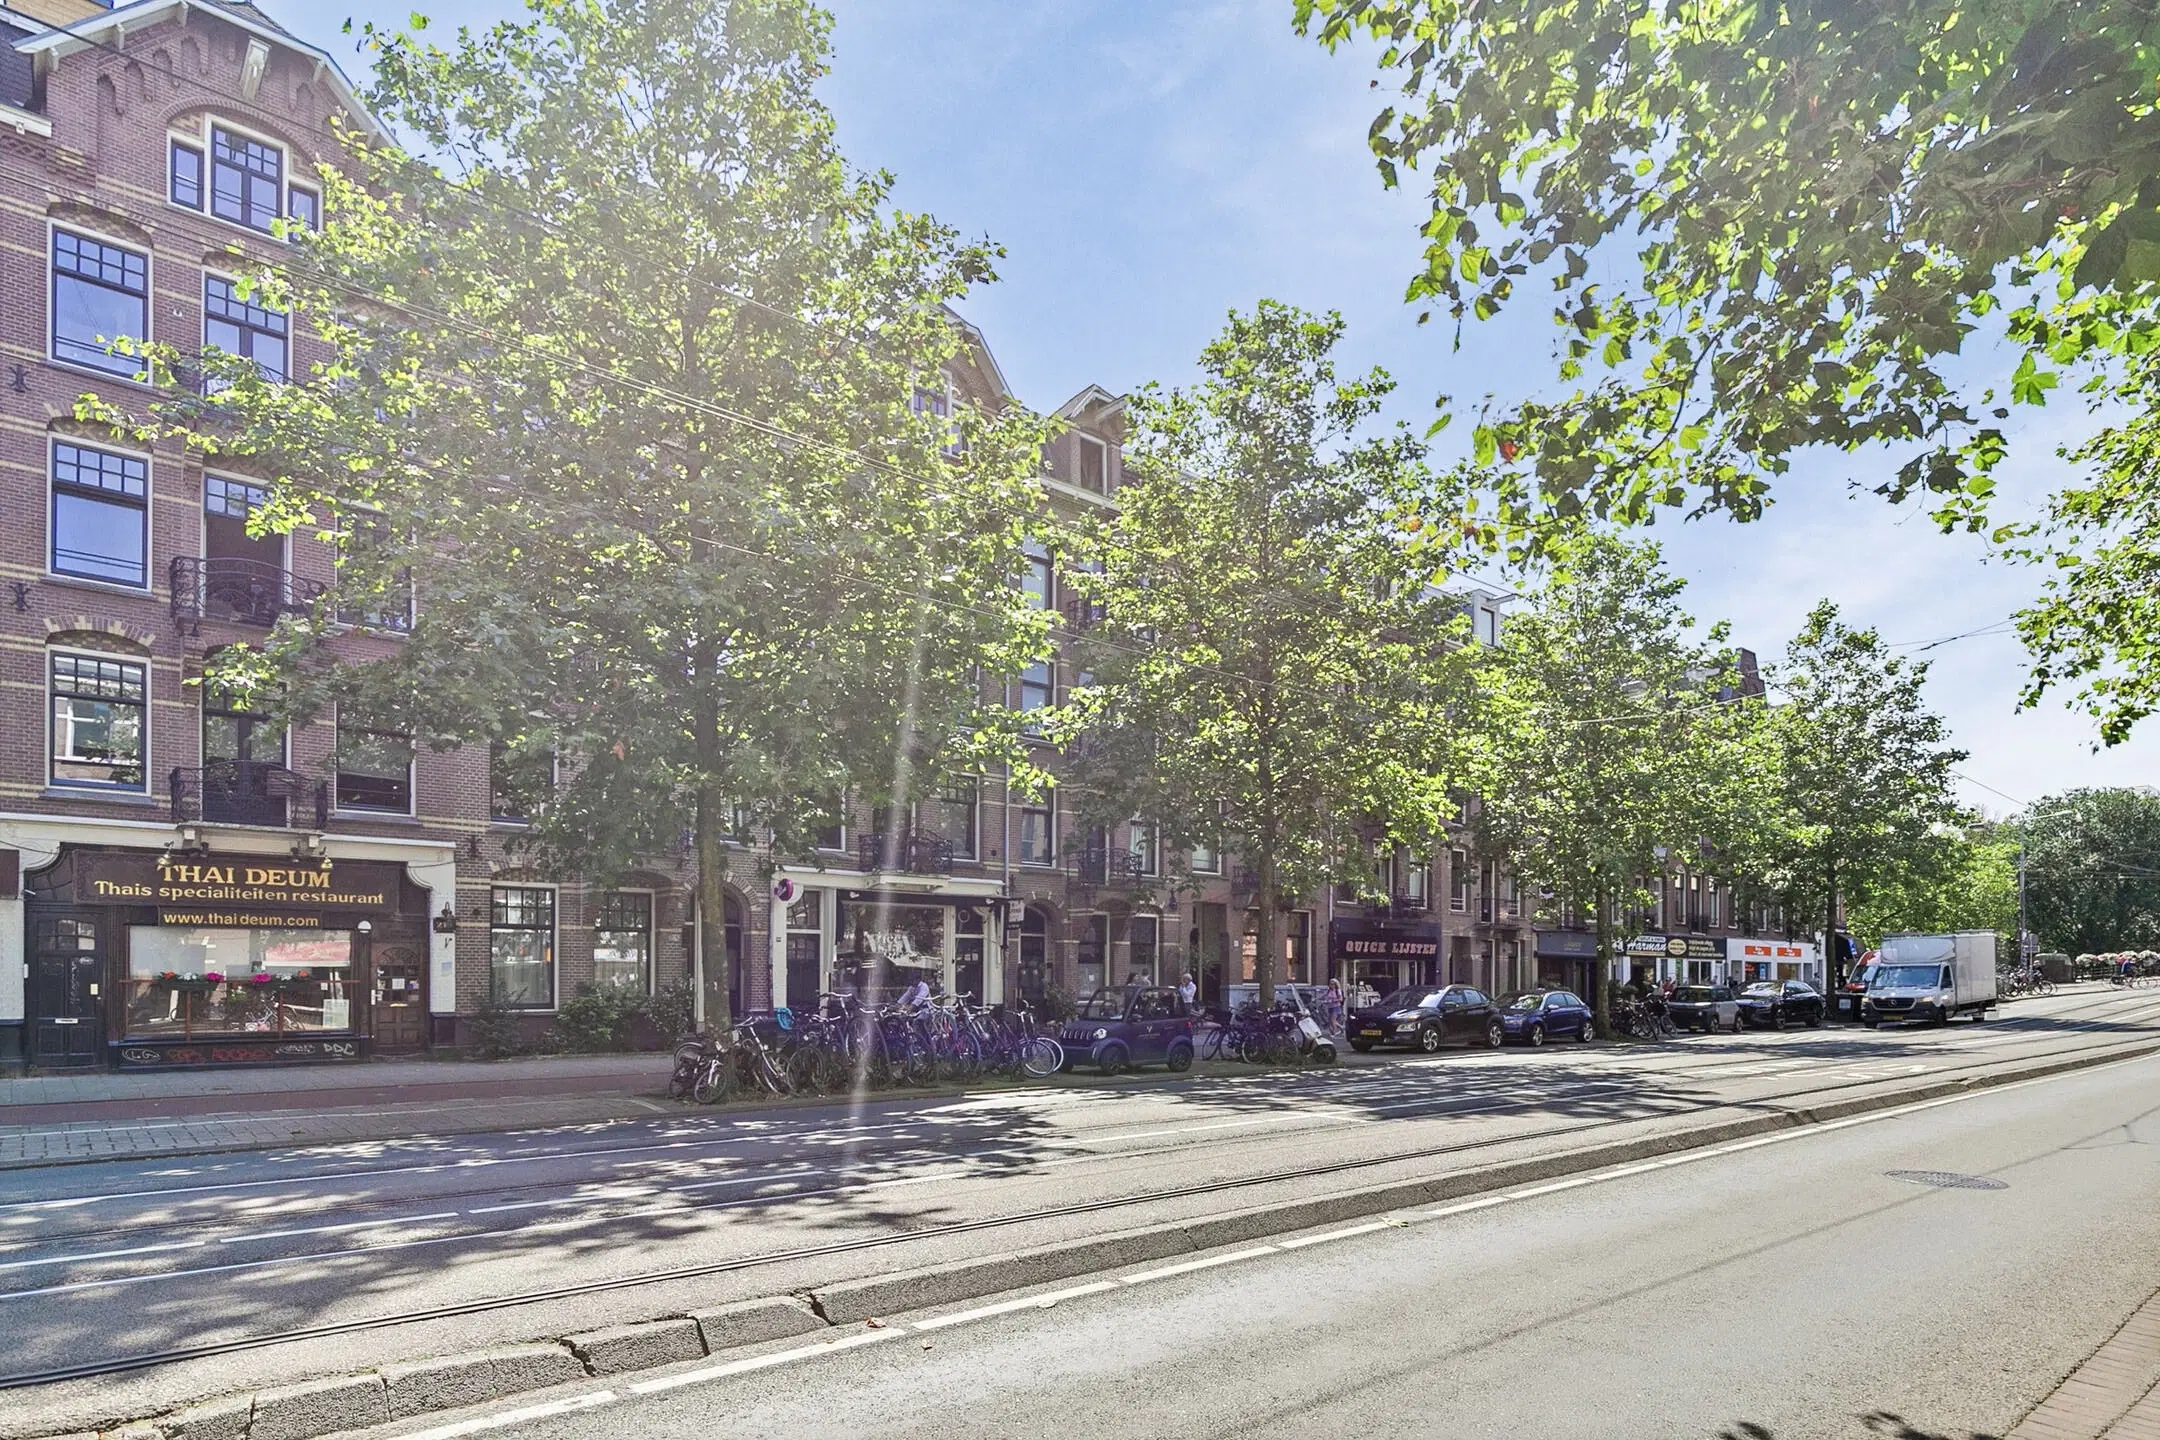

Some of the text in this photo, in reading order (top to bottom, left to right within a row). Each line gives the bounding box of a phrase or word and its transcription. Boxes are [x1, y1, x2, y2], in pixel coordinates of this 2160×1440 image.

[157, 864, 331, 888] THAI DEUM
[94, 880, 384, 904] Thais specialiteiten restaurant
[163, 912, 319, 927] www.thaideum.com
[1345, 940, 1438, 955] QUICK LIJSTEN
